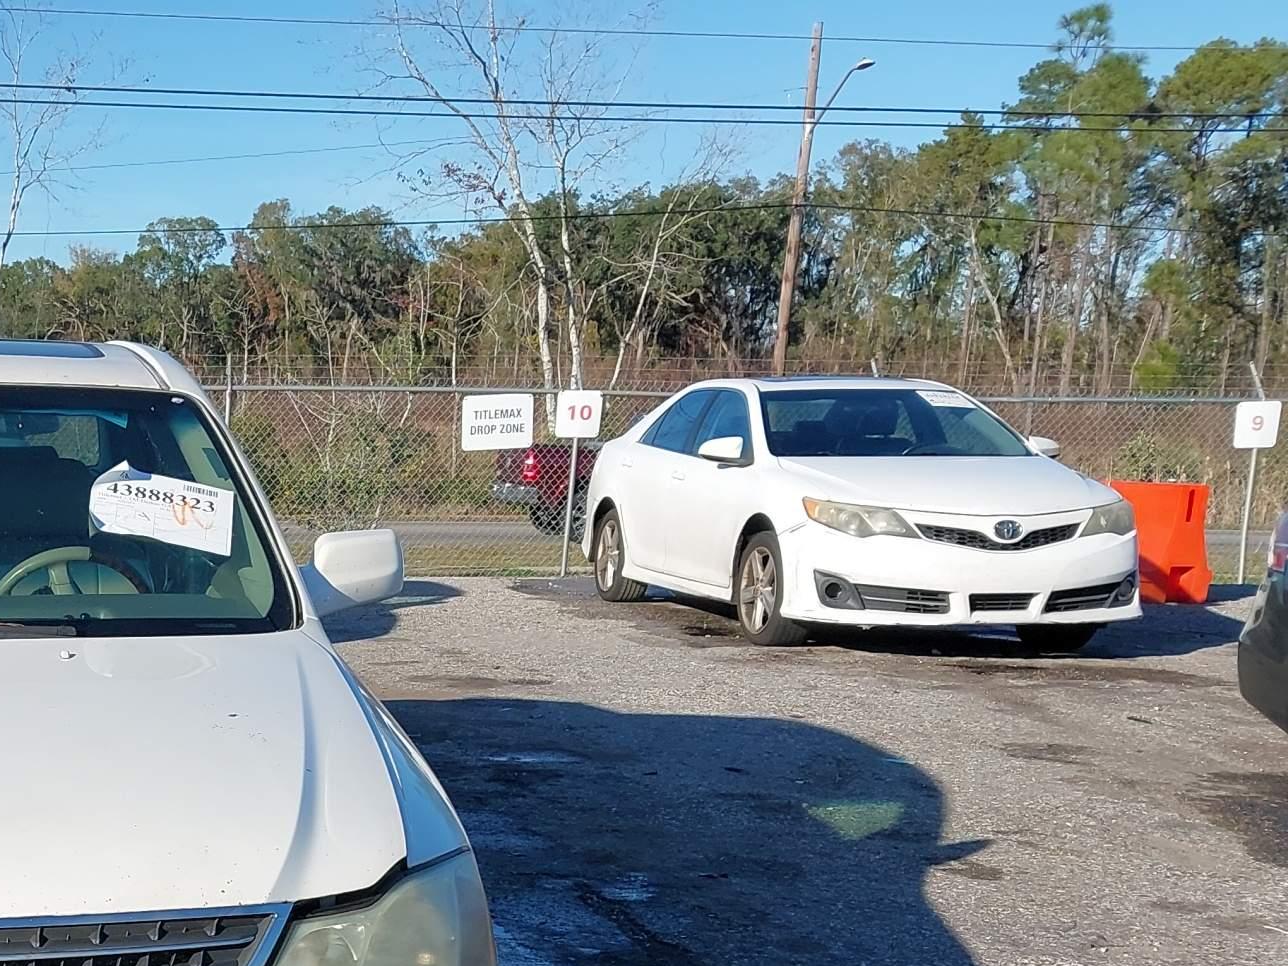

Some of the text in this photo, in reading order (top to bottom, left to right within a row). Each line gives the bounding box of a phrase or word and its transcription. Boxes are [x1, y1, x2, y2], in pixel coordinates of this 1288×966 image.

[474, 408, 522, 421] TITLEMAX
[567, 404, 592, 421] 10
[470, 423, 525, 435] DROP ZONE
[1251, 415, 1264, 431] 9
[107, 482, 215, 513] 43888323
